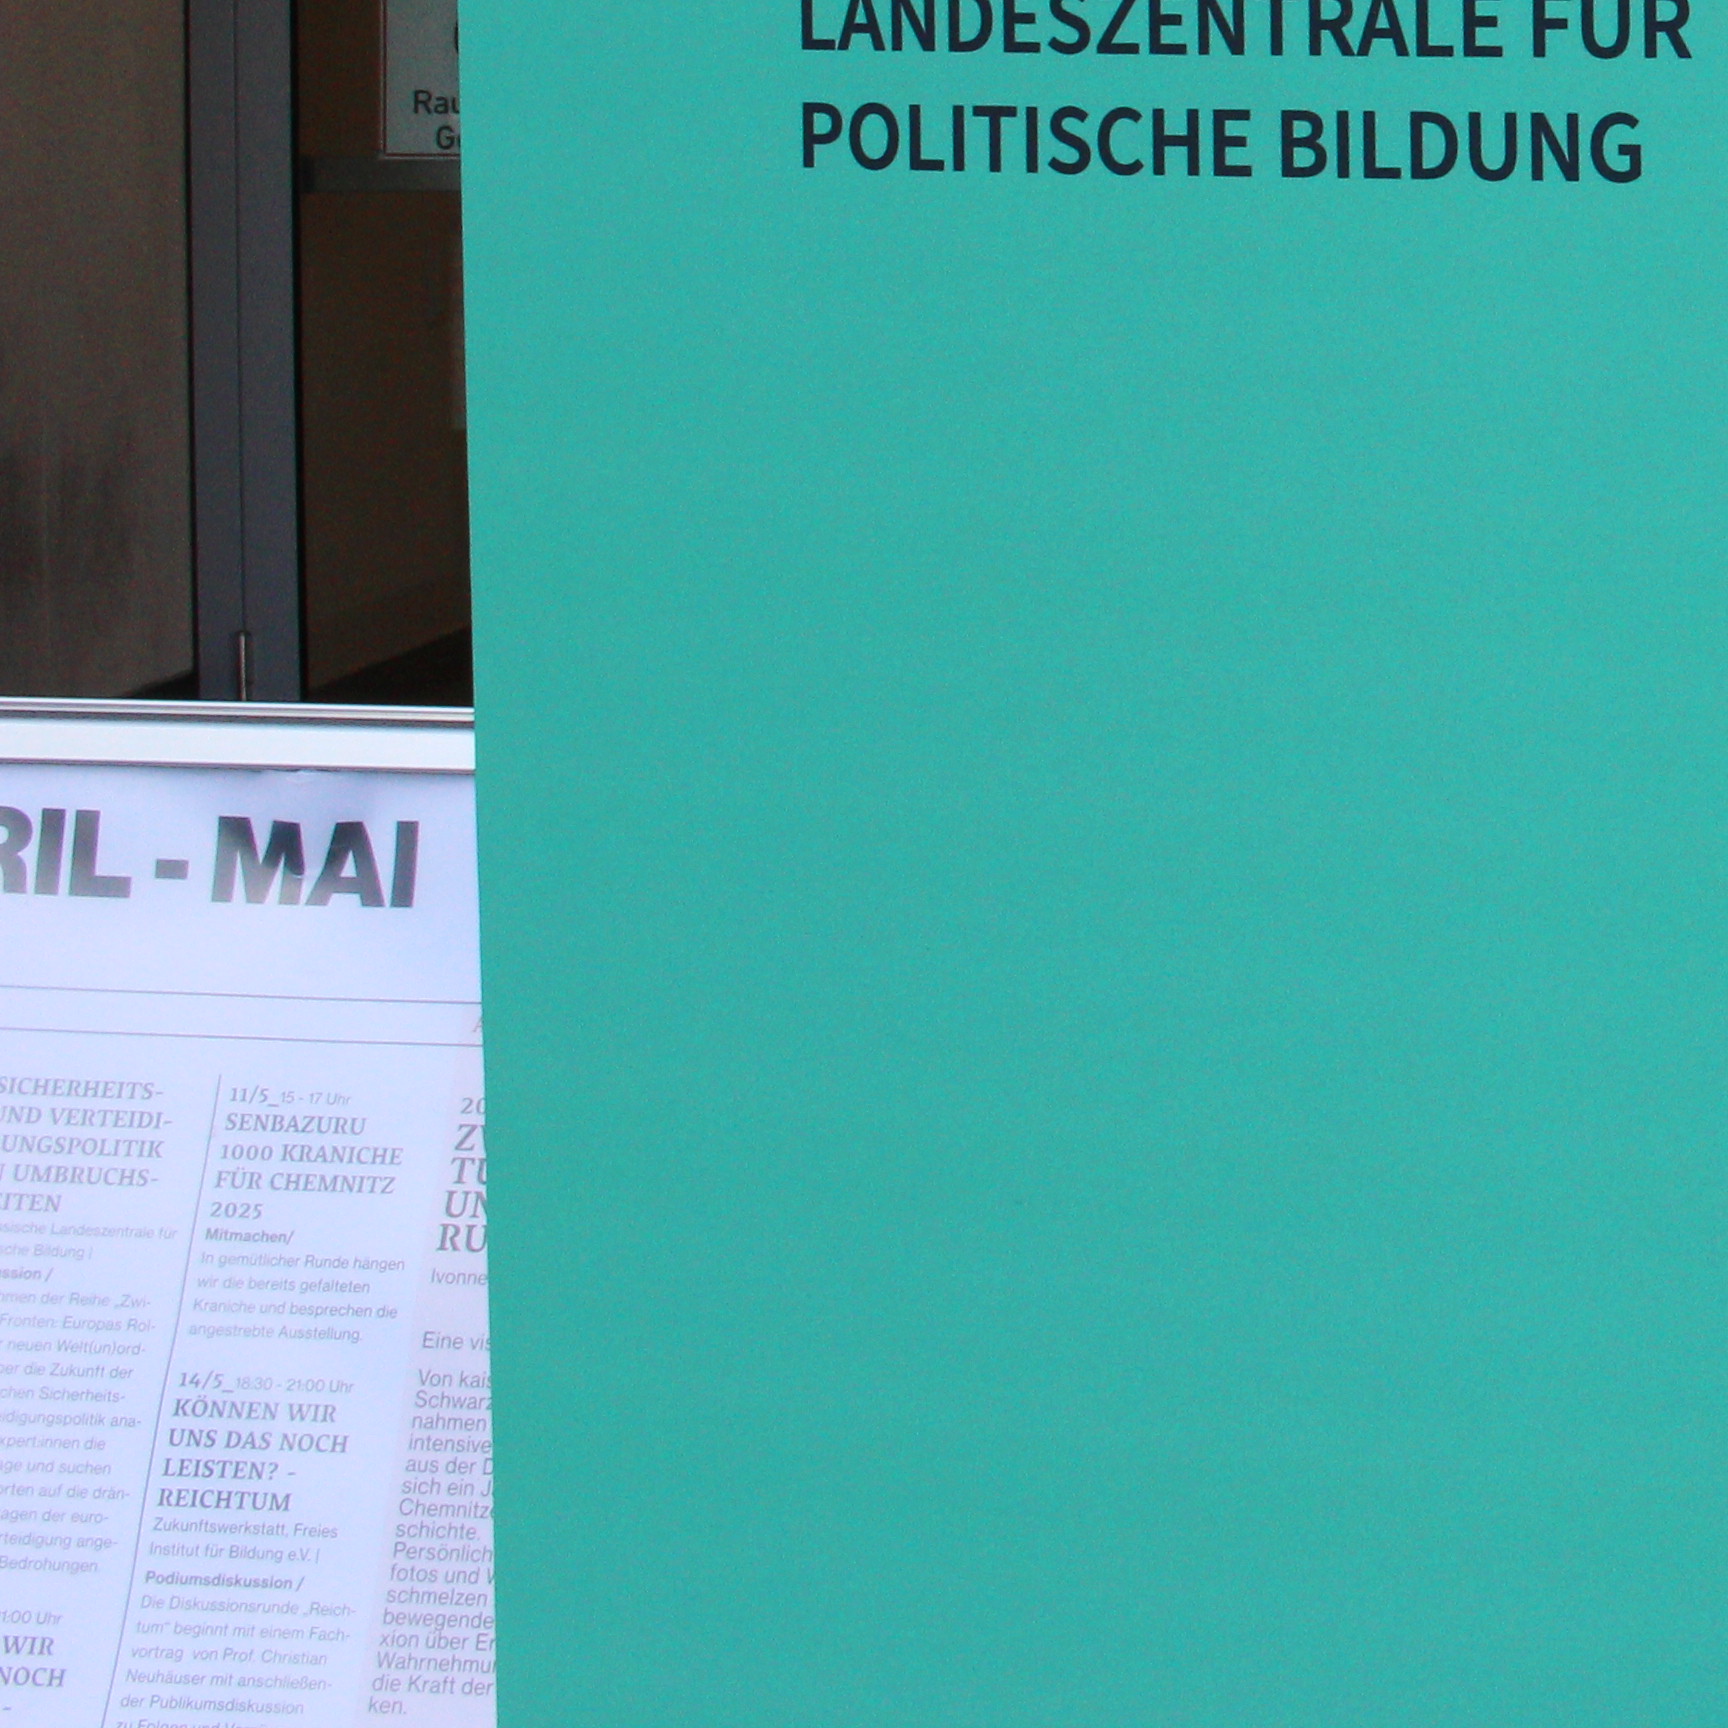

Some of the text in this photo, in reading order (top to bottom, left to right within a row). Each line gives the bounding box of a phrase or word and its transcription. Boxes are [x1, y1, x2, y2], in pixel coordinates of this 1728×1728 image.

[802, 102, 1644, 184] POLITISCHE BILDUNG
[211, 816, 420, 907] MAI
[327, 1092, 351, 1106] Uhr
[50, 1107, 172, 1129] VERTEIDI-
[225, 1113, 367, 1135] SENBAZURU
[220, 1144, 403, 1165] 1000 KRANICHE
[14, 1164, 158, 1187] UMBRUCHS-
[215, 1167, 396, 1194] FÜR CHEMNITZ
[211, 1201, 263, 1220] 2025
[205, 1227, 294, 1245] Mitmachen/
[304, 1255, 349, 1269] Runde
[353, 1257, 405, 1272] hängen
[223, 1277, 244, 1289] die
[248, 1278, 295, 1291] bereits
[300, 1279, 370, 1294] gefalteten
[194, 1299, 398, 1319] Kraniche und besprechen die
[189, 1324, 274, 1338] angestrebte
[422, 1331, 463, 1349] Eine
[330, 1379, 354, 1393] Uhr
[419, 1369, 452, 1387] Von
[172, 1395, 336, 1422] KÖNNEN WIR
[412, 1413, 487, 1431] nahmen
[169, 1428, 349, 1453] UNS DAS NOCH
[408, 1433, 492, 1453] intensive
[162, 1458, 279, 1480] LEISTEN?
[406, 1457, 477, 1474] aus der
[402, 1477, 474, 1496] sich ein
[158, 1488, 292, 1512] REICHTUM
[399, 1498, 493, 1518] Chemnitz
[153, 1517, 338, 1538] Zukunftswerkstatt, Freies
[396, 1522, 481, 1540] schichte.
[150, 1542, 200, 1557] Institut
[204, 1543, 224, 1557] für
[229, 1545, 283, 1563] Bildung
[145, 1570, 293, 1590] Podiumsdiskussion
[391, 1563, 480, 1584] fotos und
[141, 1595, 165, 1609] Die
[169, 1596, 299, 1614] Diskussionsrunde
[386, 1586, 487, 1607] schmelzen
[383, 1607, 494, 1631] bewegende
[174, 1622, 228, 1639] beginnt
[233, 1623, 255, 1637] mit
[260, 1626, 304, 1639] einem
[380, 1630, 468, 1650] xion über
[3, 1635, 54, 1656] WIR
[132, 1645, 184, 1662] vortrag
[192, 1650, 218, 1661] von
[261, 1650, 327, 1665] Christian
[125, 1669, 205, 1686] Neuhäuser
[210, 1673, 233, 1686] mit
[372, 1674, 494, 1696] die Kraft der
[121, 1694, 303, 1714] der Publikumsdiskussion
[368, 1696, 406, 1714] ken.
